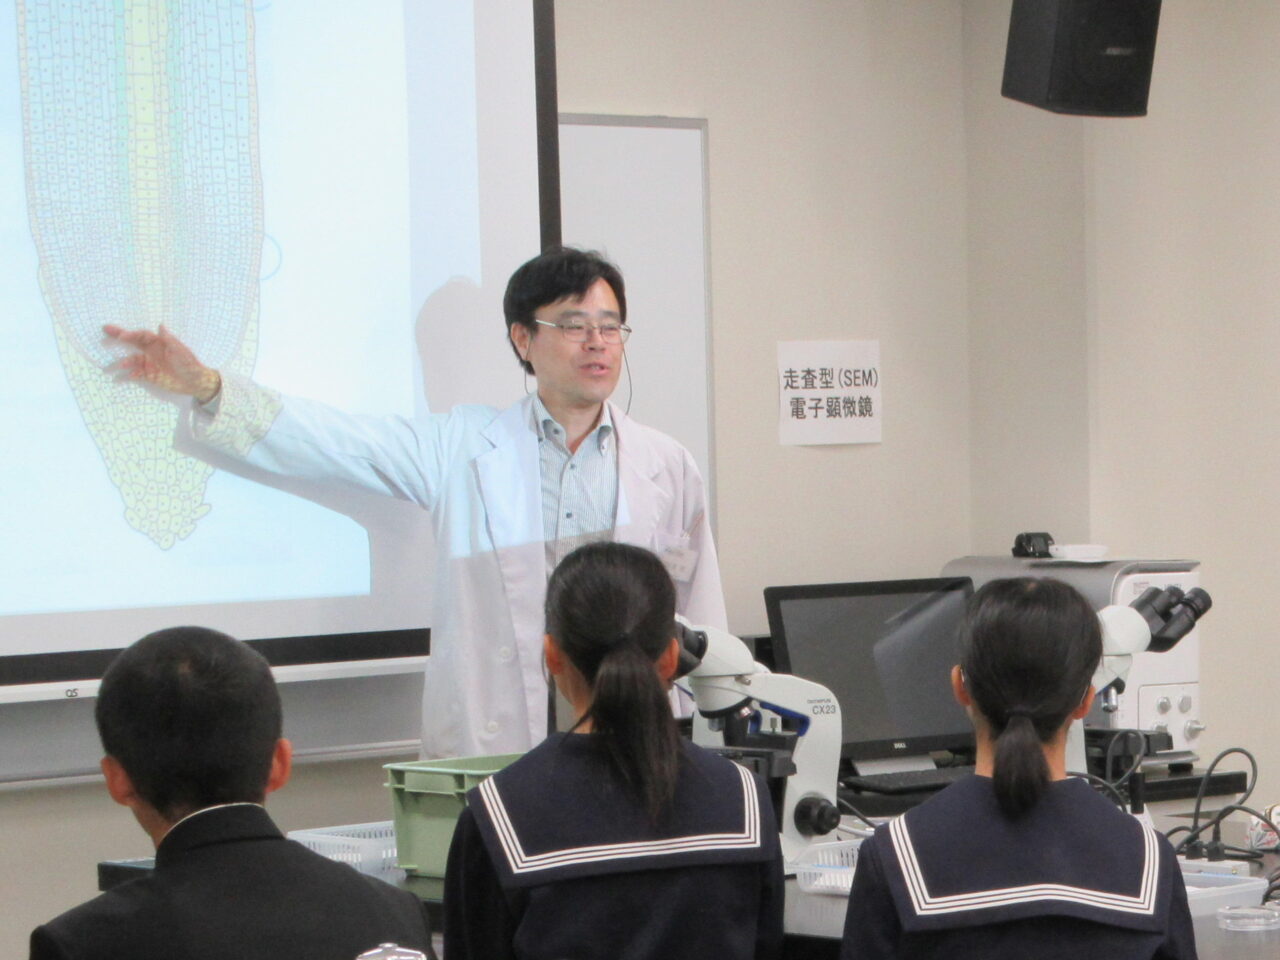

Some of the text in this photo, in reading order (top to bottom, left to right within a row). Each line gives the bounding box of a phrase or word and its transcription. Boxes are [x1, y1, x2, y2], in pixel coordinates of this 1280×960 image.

[783, 367, 879, 390] 走査型(SEM)
[789, 395, 874, 420] 電子顕微鏡
[812, 704, 836, 715] CX23
